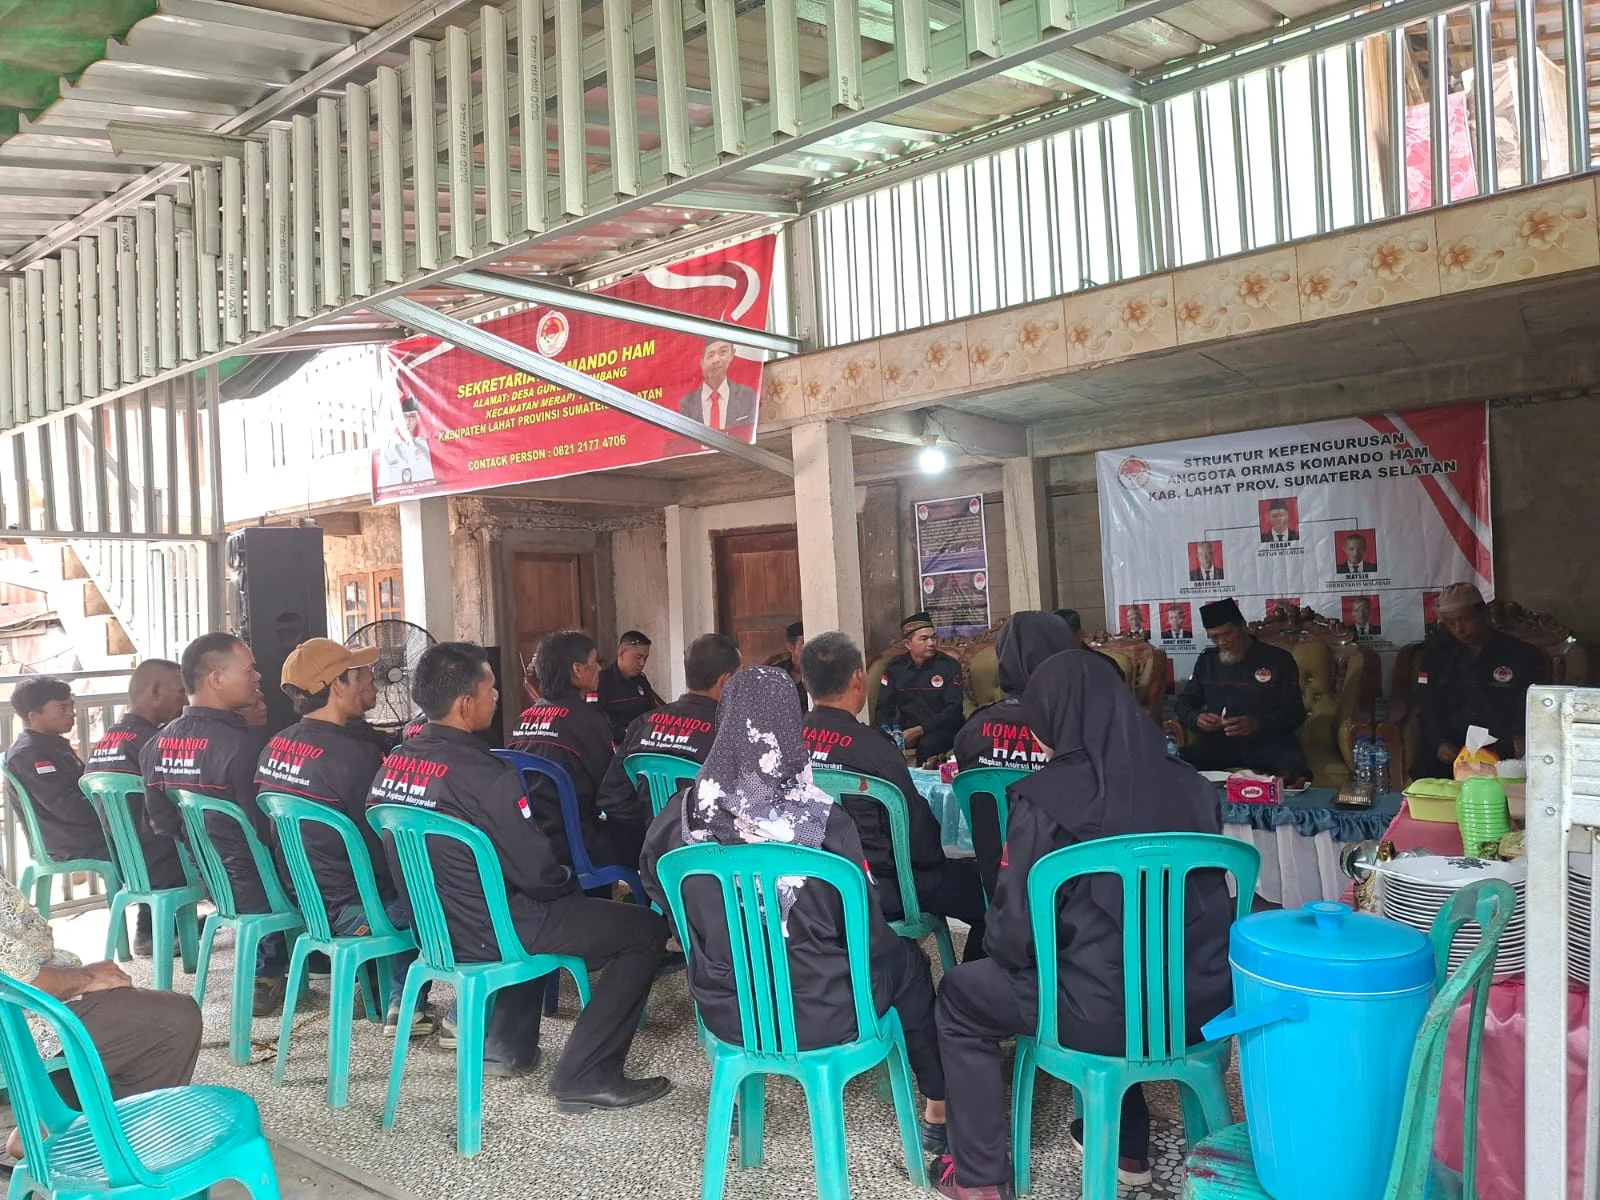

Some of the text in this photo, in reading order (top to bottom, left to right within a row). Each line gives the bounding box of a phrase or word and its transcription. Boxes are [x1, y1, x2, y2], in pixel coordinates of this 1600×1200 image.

[457, 370, 541, 399] SEKRETARIA
[622, 339, 656, 362] HAM
[473, 394, 510, 409] ALAMAT:
[511, 387, 535, 401] DESA
[485, 400, 539, 419] KECAMATAN
[438, 423, 487, 442] KABUPATEN
[488, 417, 516, 433] LAHAT
[518, 408, 560, 426] PROVINSI
[468, 456, 508, 471] CONTACK
[510, 449, 546, 465] PERSON
[553, 443, 575, 458] 0821
[577, 438, 599, 453] 2177
[602, 434, 627, 449] 4706
[1184, 432, 1405, 469] STRUKTUR KEPENGURUSAN
[1168, 446, 1429, 485] ANGGOTA ORMAS KOMANDO HAM
[1149, 460, 1457, 502] KAB. LAHAT PROV. SUMATERA SELATAN
[520, 715, 555, 730] HAM
[647, 712, 712, 733] KOMANDO
[650, 723, 694, 745] HAM
[982, 722, 1031, 740] KOMA
[93, 740, 122, 757] HAM
[162, 749, 196, 767] HAM
[992, 737, 1050, 763] HAM
[267, 749, 305, 776] HAM
[381, 768, 430, 797] HAM
